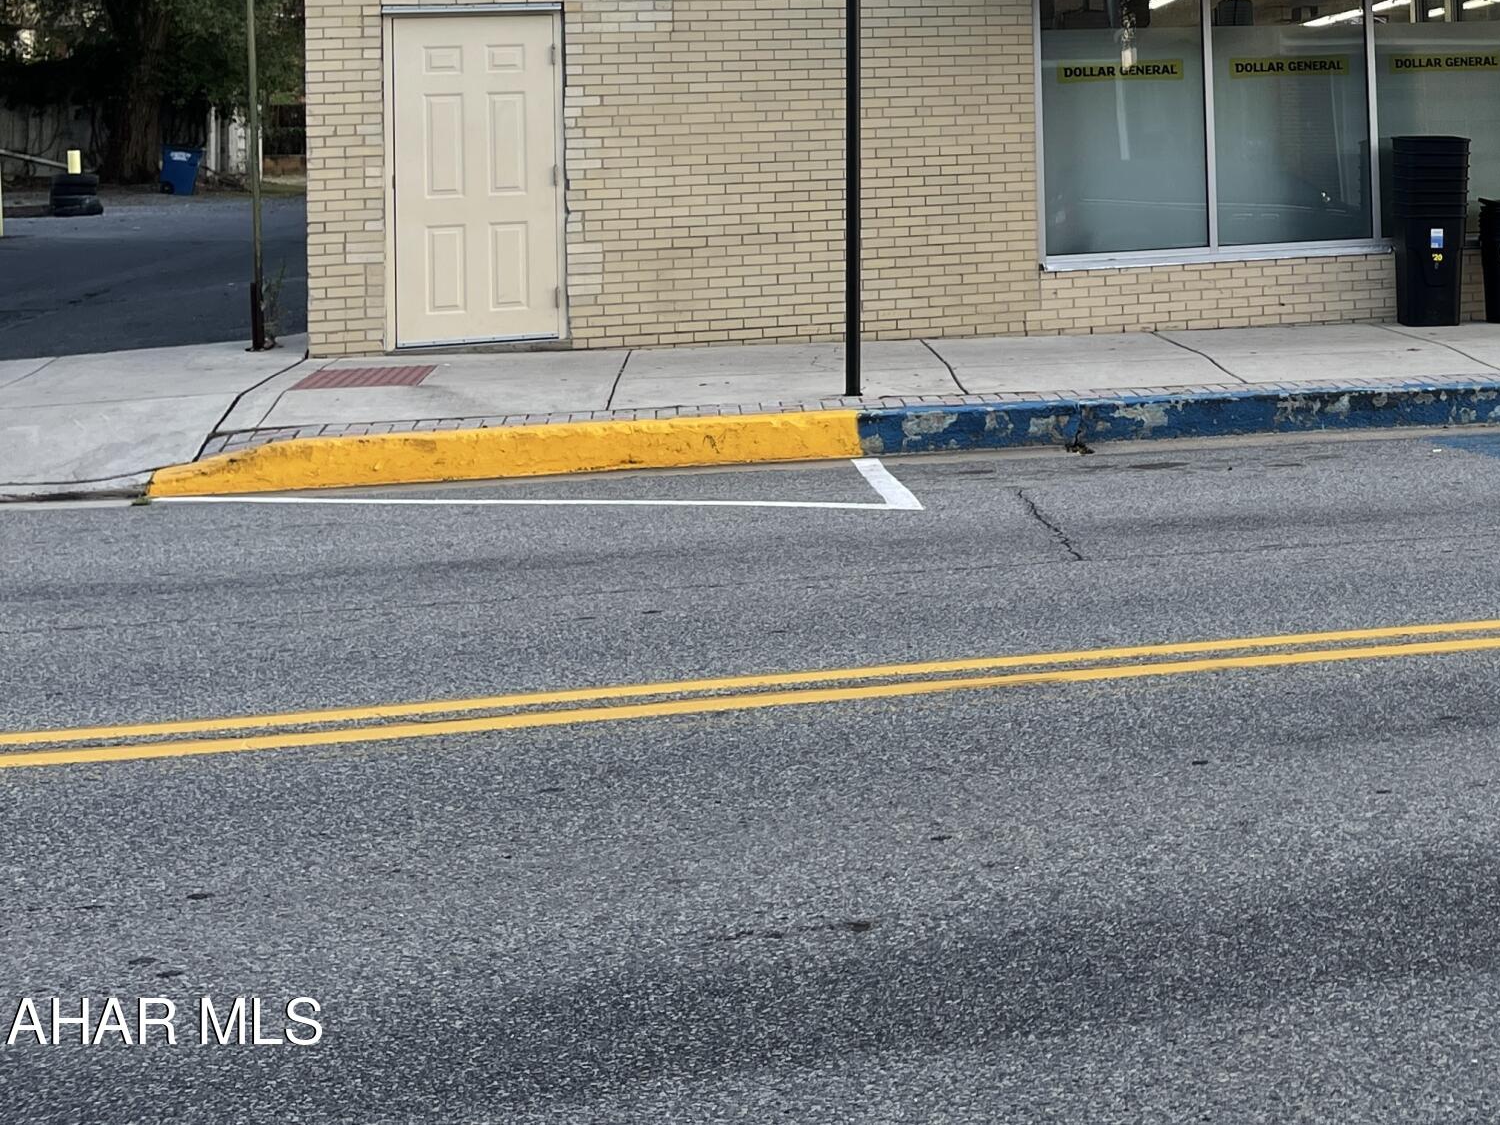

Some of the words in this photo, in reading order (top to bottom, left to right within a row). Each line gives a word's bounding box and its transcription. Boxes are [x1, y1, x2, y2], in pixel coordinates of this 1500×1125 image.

[1235, 61, 1285, 73] DOLLAR
[1288, 59, 1344, 72] GENERAL
[1394, 57, 1442, 69] DOLLAR
[1445, 56, 1499, 67] GENERAL
[1063, 66, 1116, 78] DOLLAR
[1119, 63, 1178, 76] GENERAL
